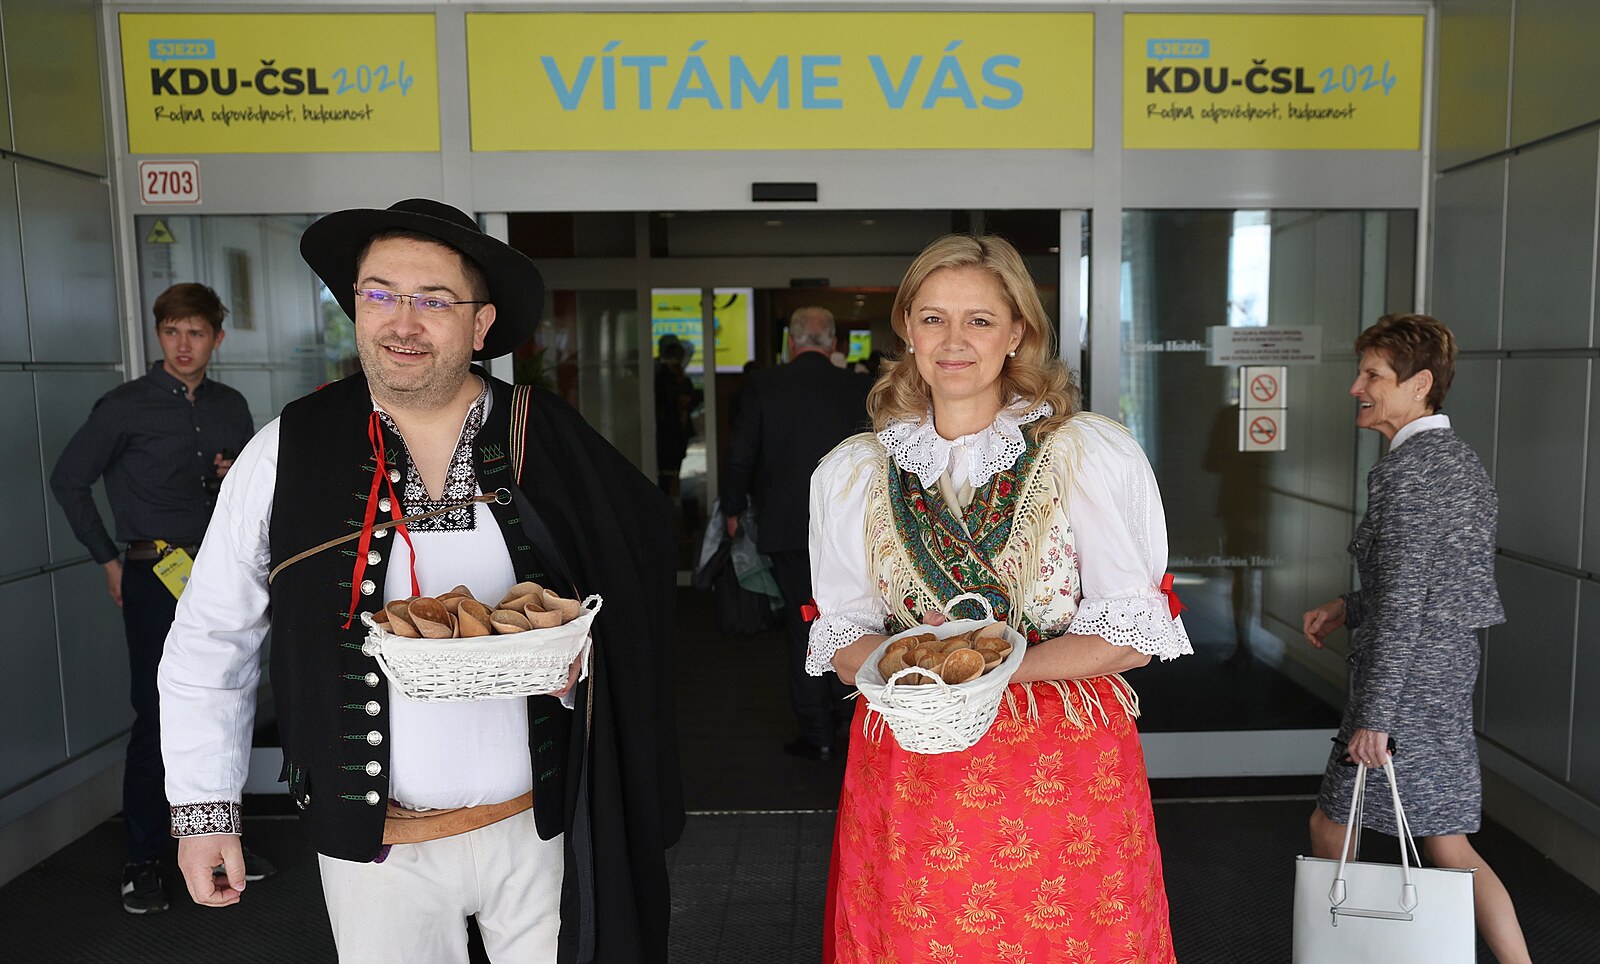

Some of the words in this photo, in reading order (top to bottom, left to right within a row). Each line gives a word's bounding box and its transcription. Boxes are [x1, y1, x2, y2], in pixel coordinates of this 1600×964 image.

[156, 43, 209, 56] SJEZD
[1153, 43, 1204, 56] SJEZD
[150, 60, 329, 96] KDU-ČSL
[331, 60, 414, 97] 2026
[541, 39, 843, 111] VÍTÁME
[867, 39, 1026, 111] VÁS
[1146, 59, 1315, 95] KDU-ČSL
[1318, 60, 1397, 97] 2026
[212, 104, 296, 127] odpovědnost,
[302, 104, 374, 125] budoucnost
[1201, 102, 1282, 125] odpovědnost,
[1288, 102, 1358, 122] budoucnost
[146, 171, 194, 195] 2703
